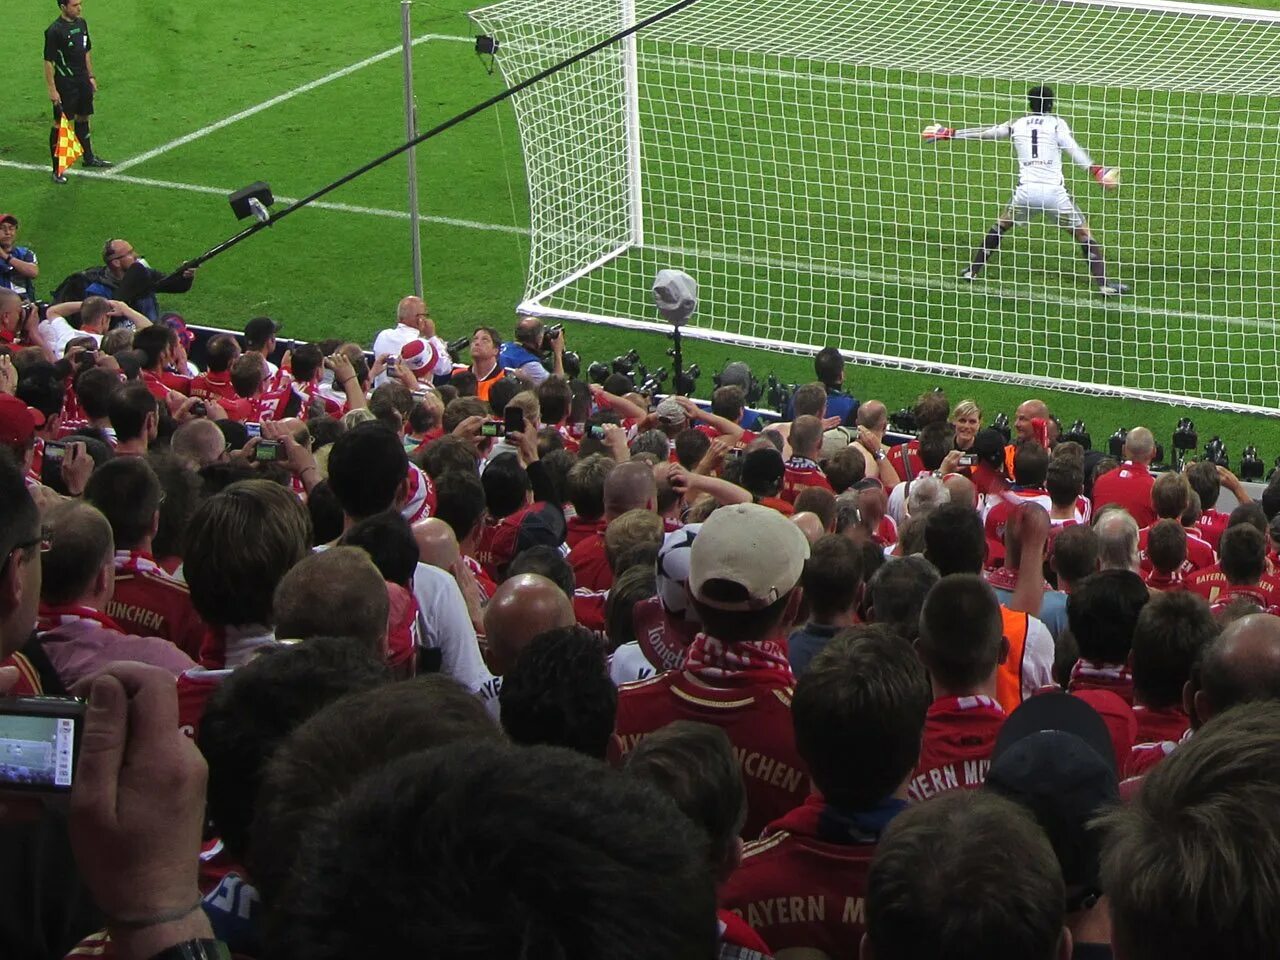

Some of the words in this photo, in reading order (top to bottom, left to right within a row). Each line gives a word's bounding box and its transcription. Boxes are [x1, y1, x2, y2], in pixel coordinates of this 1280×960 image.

[1031, 128, 1038, 158] 1
[893, 447, 918, 459] BARN
[1196, 572, 1226, 585] BAYERN
